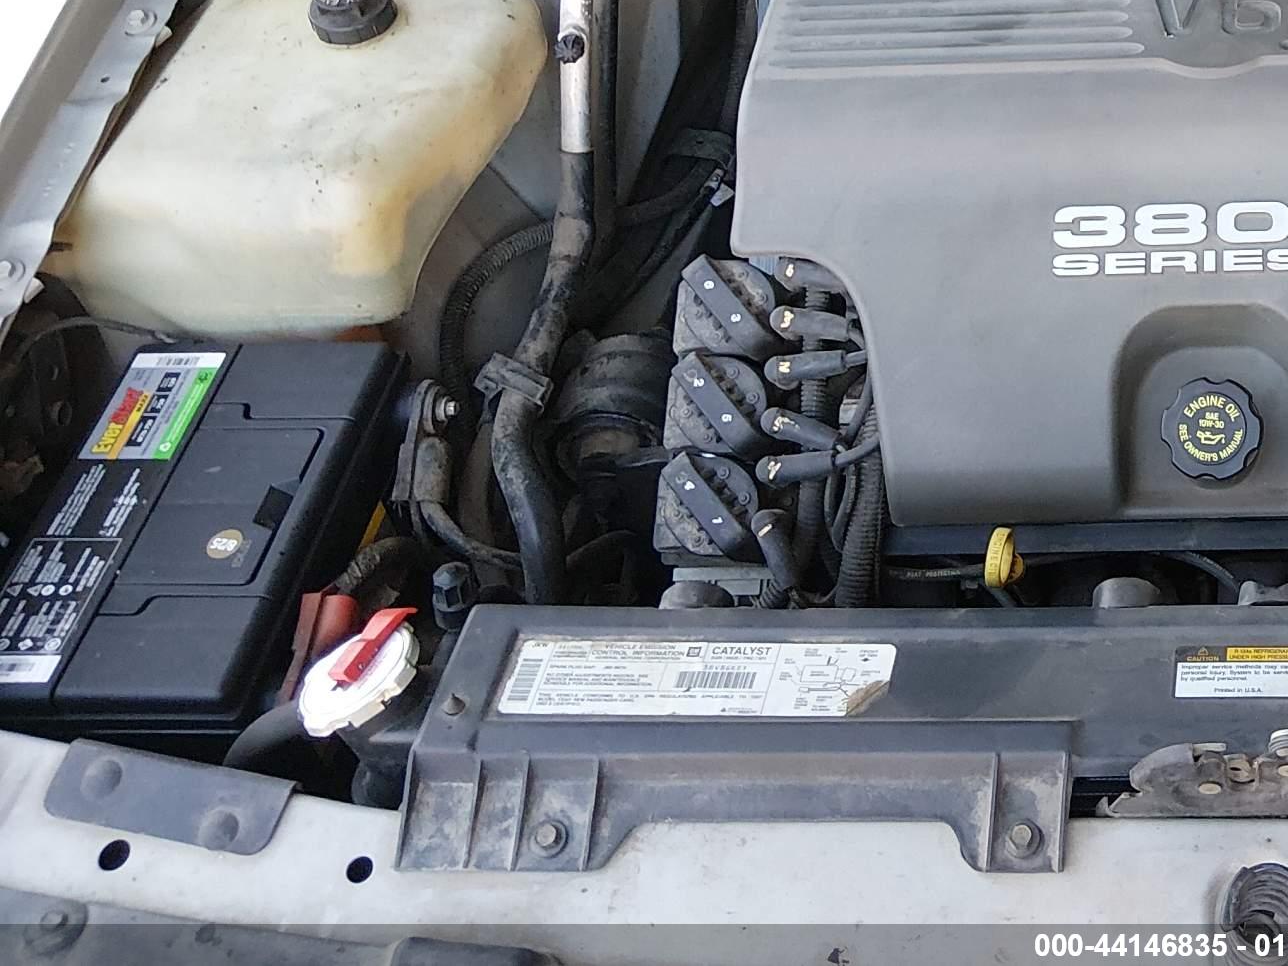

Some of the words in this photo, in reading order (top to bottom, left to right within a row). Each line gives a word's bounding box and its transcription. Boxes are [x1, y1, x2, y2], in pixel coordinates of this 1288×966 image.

[703, 280, 715, 290] 6
[730, 313, 741, 323] 3
[693, 378, 705, 387] 2
[1183, 394, 1227, 418] ENGINE
[1225, 403, 1241, 422] OIL
[91, 387, 145, 454] EverStart
[1204, 412, 1219, 420] SAE
[1198, 419, 1225, 429] 10W-30
[1178, 424, 1188, 442] SEE
[1183, 441, 1218, 462] OWNER'S
[1218, 428, 1244, 460] MANUAL
[711, 516, 723, 524] 1
[712, 647, 773, 655] CATALYST
